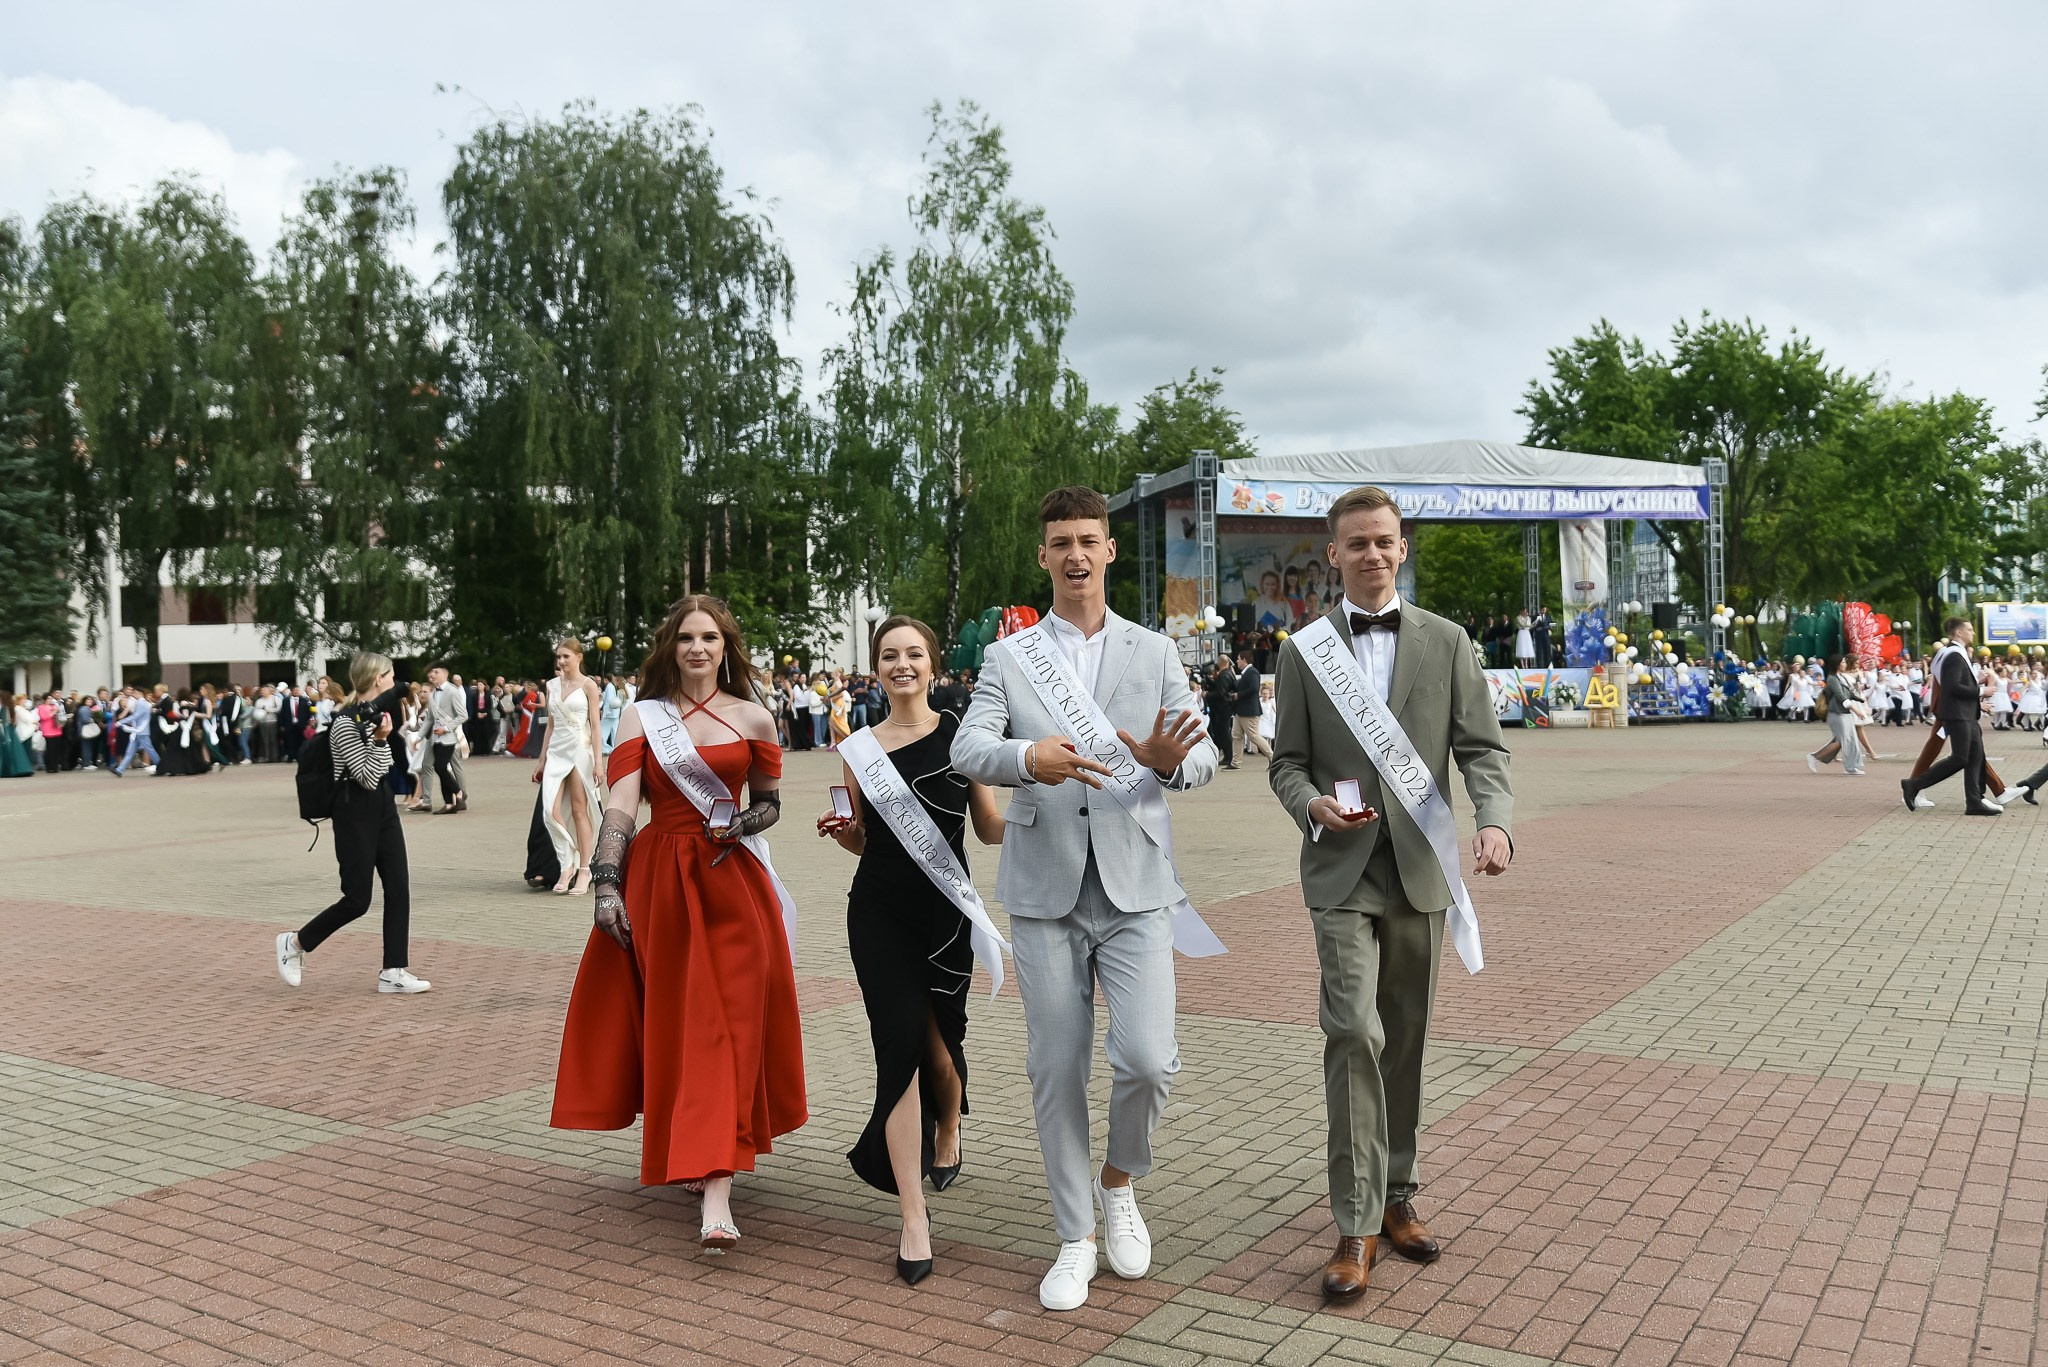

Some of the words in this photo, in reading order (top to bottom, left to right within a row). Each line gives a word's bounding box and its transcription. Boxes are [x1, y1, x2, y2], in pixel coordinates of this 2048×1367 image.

[1296, 485, 1312, 509] В
[1400, 491, 1452, 516] путь,
[1454, 487, 1551, 514] ДОРОГИЕ
[1552, 489, 1698, 512] ВЫПУСКНИКИ!
[657, 723, 716, 806] Выпускниц
[1015, 631, 1102, 751] Выпускник
[1094, 741, 1145, 795] 2024
[1311, 634, 1399, 761] Выпускник
[1390, 752, 1432, 808] 2024
[865, 757, 939, 863] Выпускница
[933, 855, 969, 899] 2024
